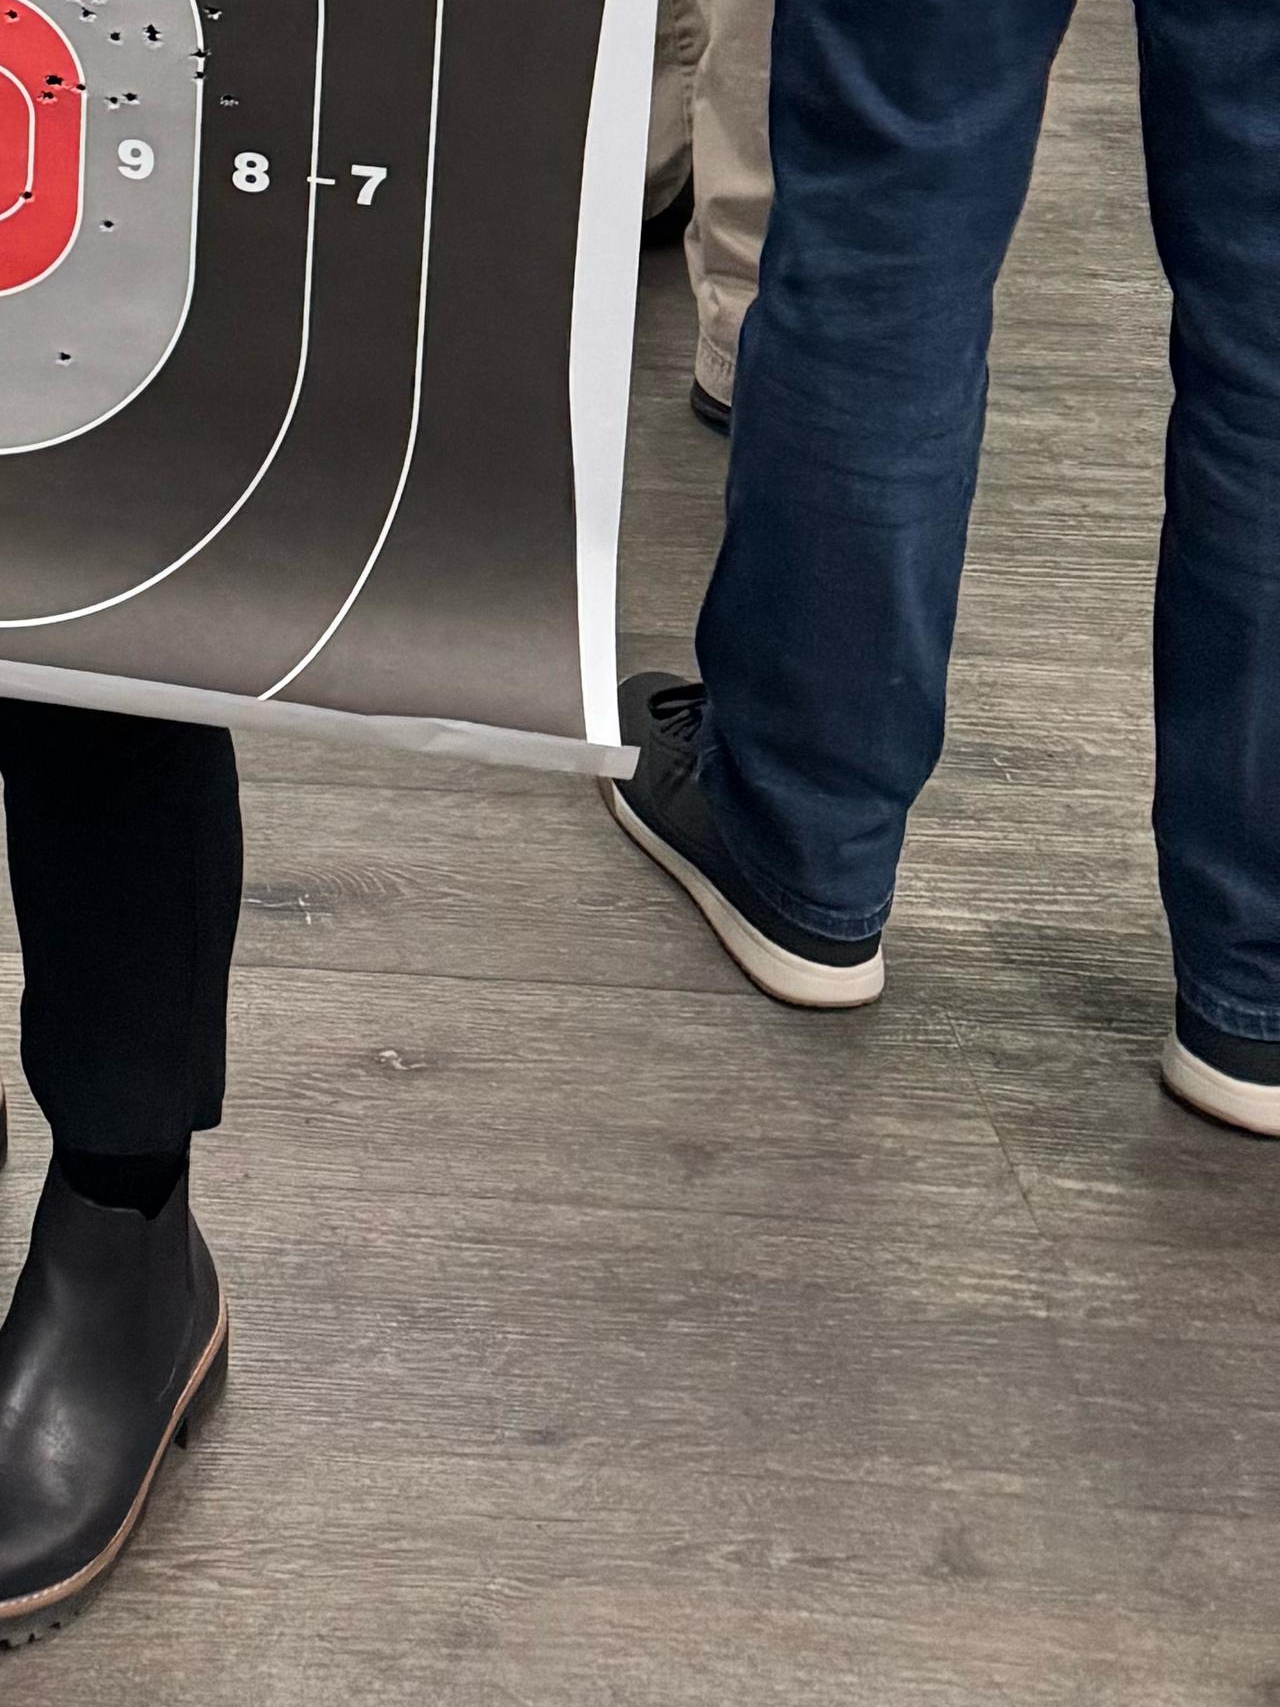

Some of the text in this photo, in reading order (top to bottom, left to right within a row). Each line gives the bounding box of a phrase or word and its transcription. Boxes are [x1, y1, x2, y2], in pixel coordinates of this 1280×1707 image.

[117, 139, 155, 180] 9
[232, 152, 270, 192] 8
[351, 164, 388, 205] 7
